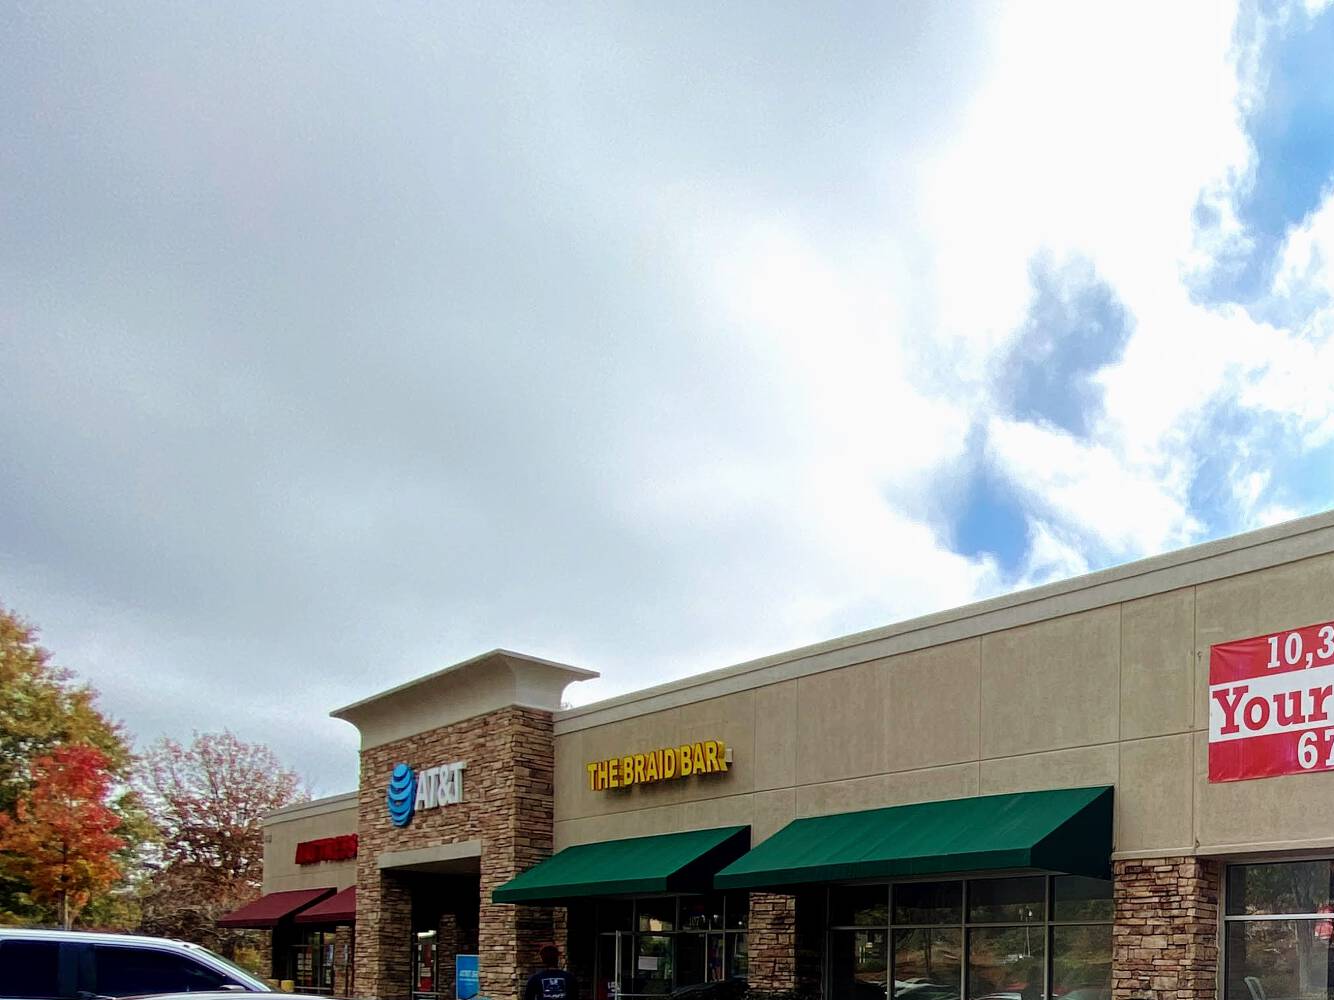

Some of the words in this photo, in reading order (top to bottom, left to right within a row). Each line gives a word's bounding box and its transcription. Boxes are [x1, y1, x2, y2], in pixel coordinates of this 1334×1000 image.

[1212, 684, 1333, 735] Your
[414, 761, 467, 811] AT&T
[587, 759, 619, 791] THE
[623, 748, 677, 786] BRAID
[680, 740, 724, 776] BAR
